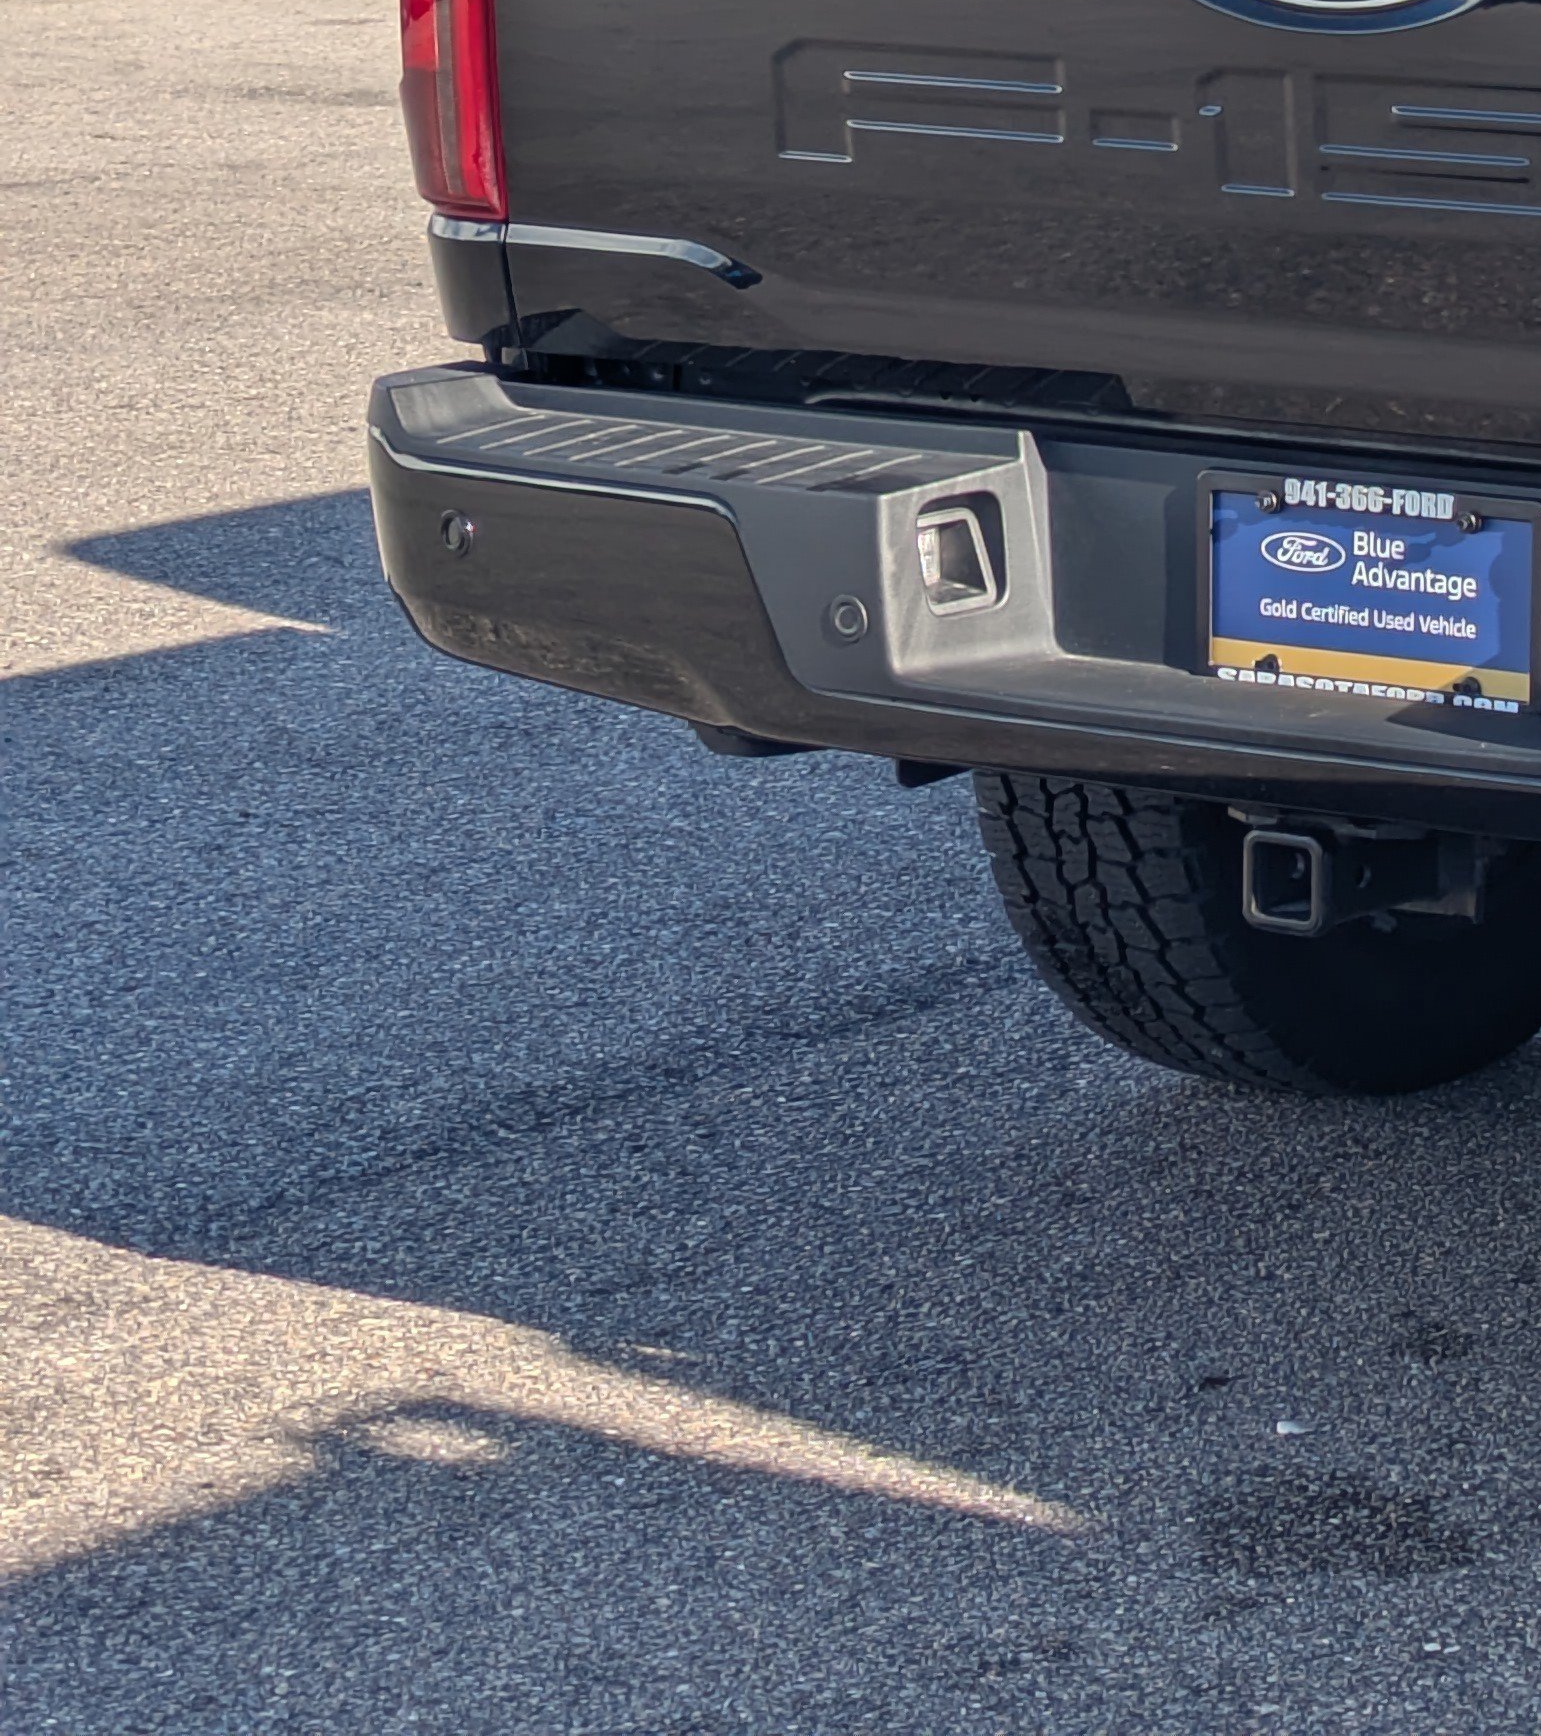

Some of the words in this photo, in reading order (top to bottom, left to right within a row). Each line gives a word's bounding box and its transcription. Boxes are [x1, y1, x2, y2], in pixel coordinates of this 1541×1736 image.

[1284, 478, 1455, 519] 941-366-FORD
[1276, 535, 1331, 566] Ford
[1353, 530, 1406, 560] Blue
[1351, 560, 1478, 600] Advantage
[1259, 597, 1298, 619] Gold
[1301, 602, 1369, 627] Certified
[1373, 609, 1415, 632] Used
[1418, 614, 1477, 639] Vehicle
